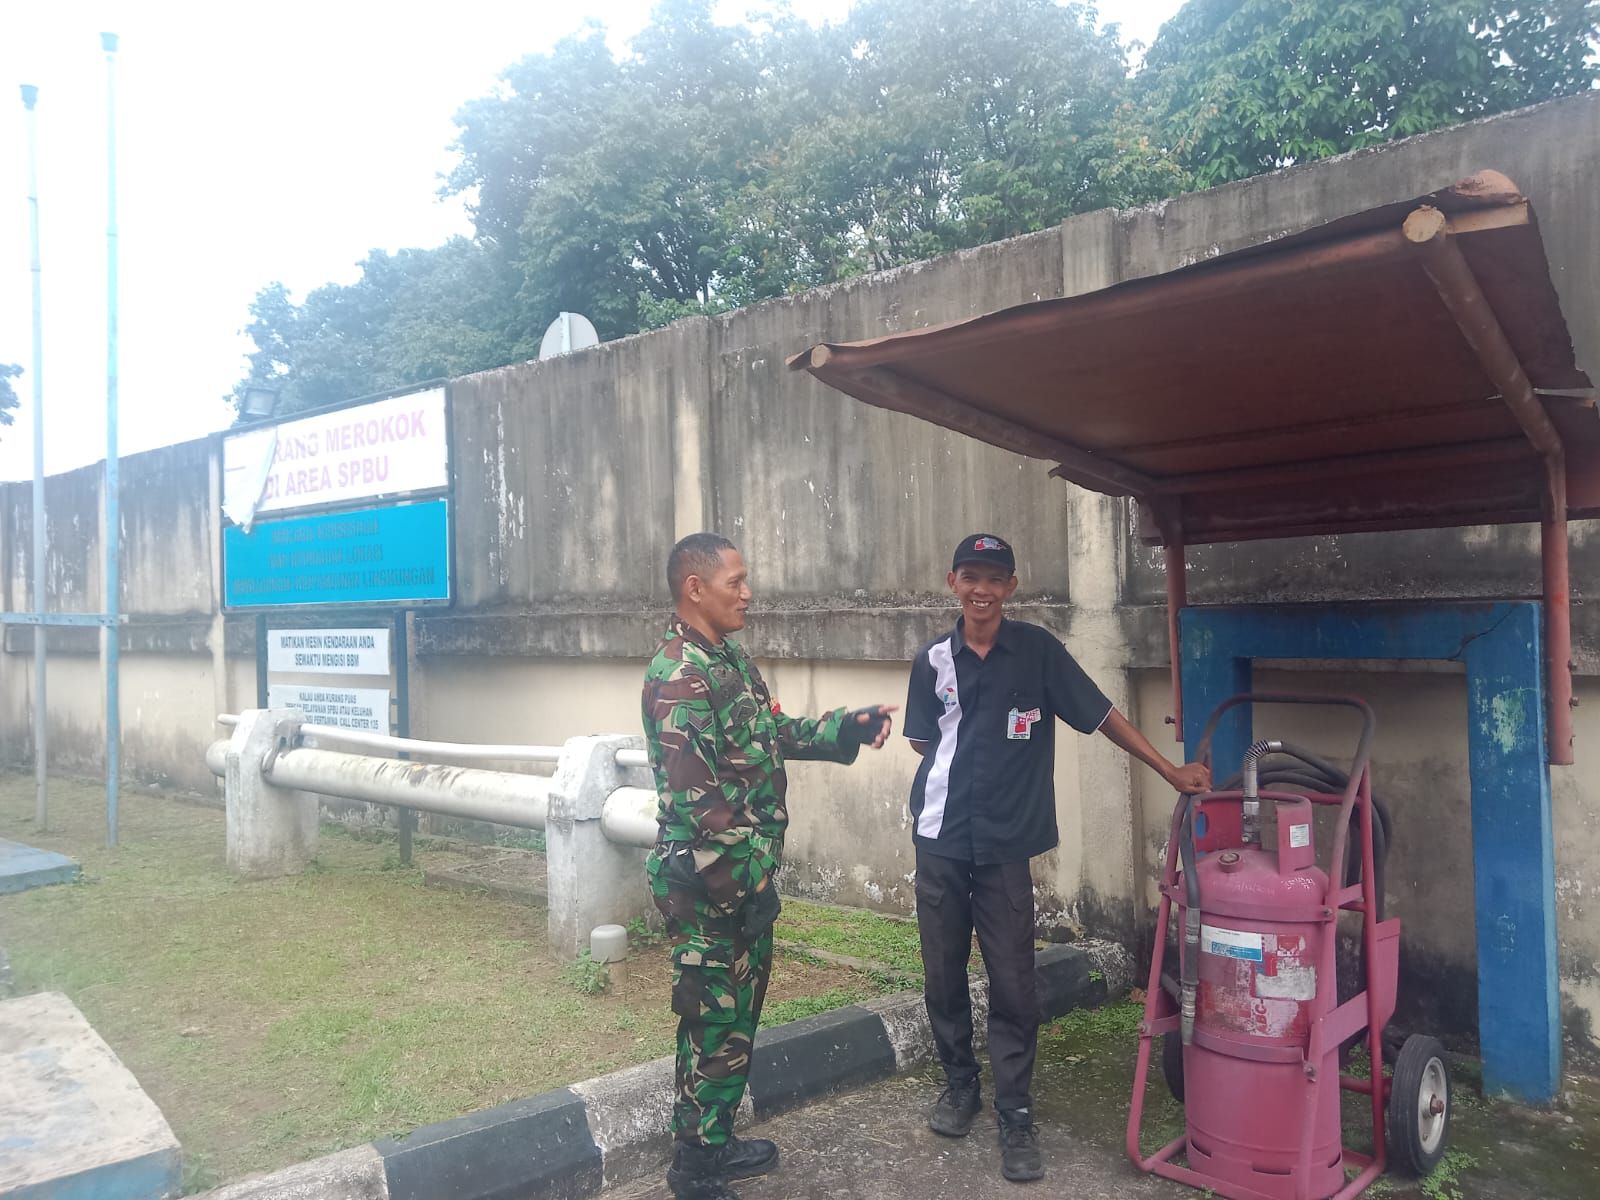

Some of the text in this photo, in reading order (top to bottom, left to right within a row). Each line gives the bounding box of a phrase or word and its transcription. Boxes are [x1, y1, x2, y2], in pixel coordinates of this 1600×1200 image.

[273, 409, 426, 464] RANG MEROKOK
[264, 455, 389, 501] DI AREA SPBU
[346, 543, 384, 563] LOKASI
[362, 566, 435, 588] LINGKUNGAN
[280, 636, 375, 649] MATIKAN MESIN KENDARAAN ANDA
[322, 654, 346, 667] MENGISI
[346, 654, 359, 667] BBM
[325, 693, 344, 704] KURANG
[302, 704, 327, 714] PELAYANAN
[327, 705, 339, 715] SPBU
[339, 717, 351, 728] CALL
[351, 718, 369, 728] CENTER
